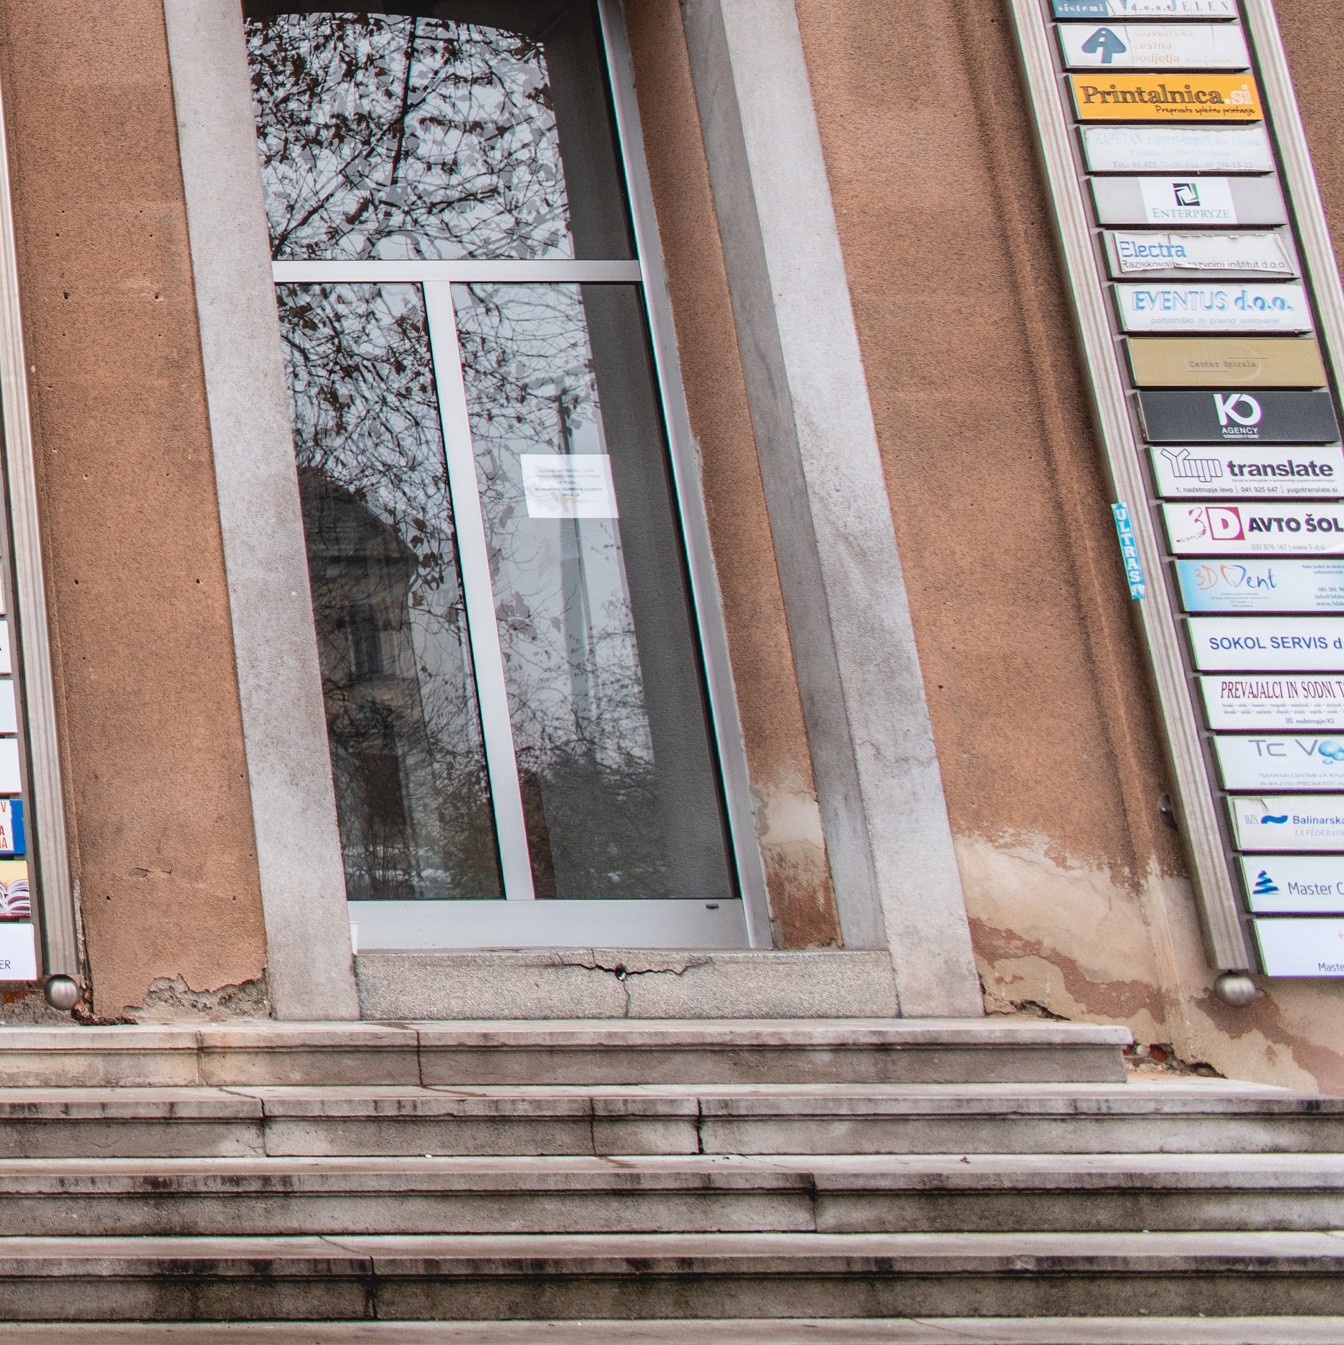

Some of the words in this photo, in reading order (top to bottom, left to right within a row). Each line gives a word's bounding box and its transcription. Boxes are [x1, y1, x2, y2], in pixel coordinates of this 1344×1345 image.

[1132, 54, 1180, 63] podjetja
[1080, 84, 1254, 105] Printalnica.si
[1119, 241, 1186, 258] Electra
[1132, 291, 1228, 311] EVENTUS
[1234, 290, 1294, 311] d.o.o.
[1224, 361, 1256, 369] Spirala
[1227, 460, 1333, 477] translate
[1248, 517, 1301, 532] AVTO
[1115, 507, 1142, 582] ULTRAS
[1210, 637, 1266, 650] SOKOL
[1271, 637, 1328, 649] SERVIS
[1221, 682, 1283, 698] PREVAJALCI
[1288, 682, 1299, 698] IN
[1303, 682, 1331, 698] SODNI
[1288, 883, 1331, 895] Master
